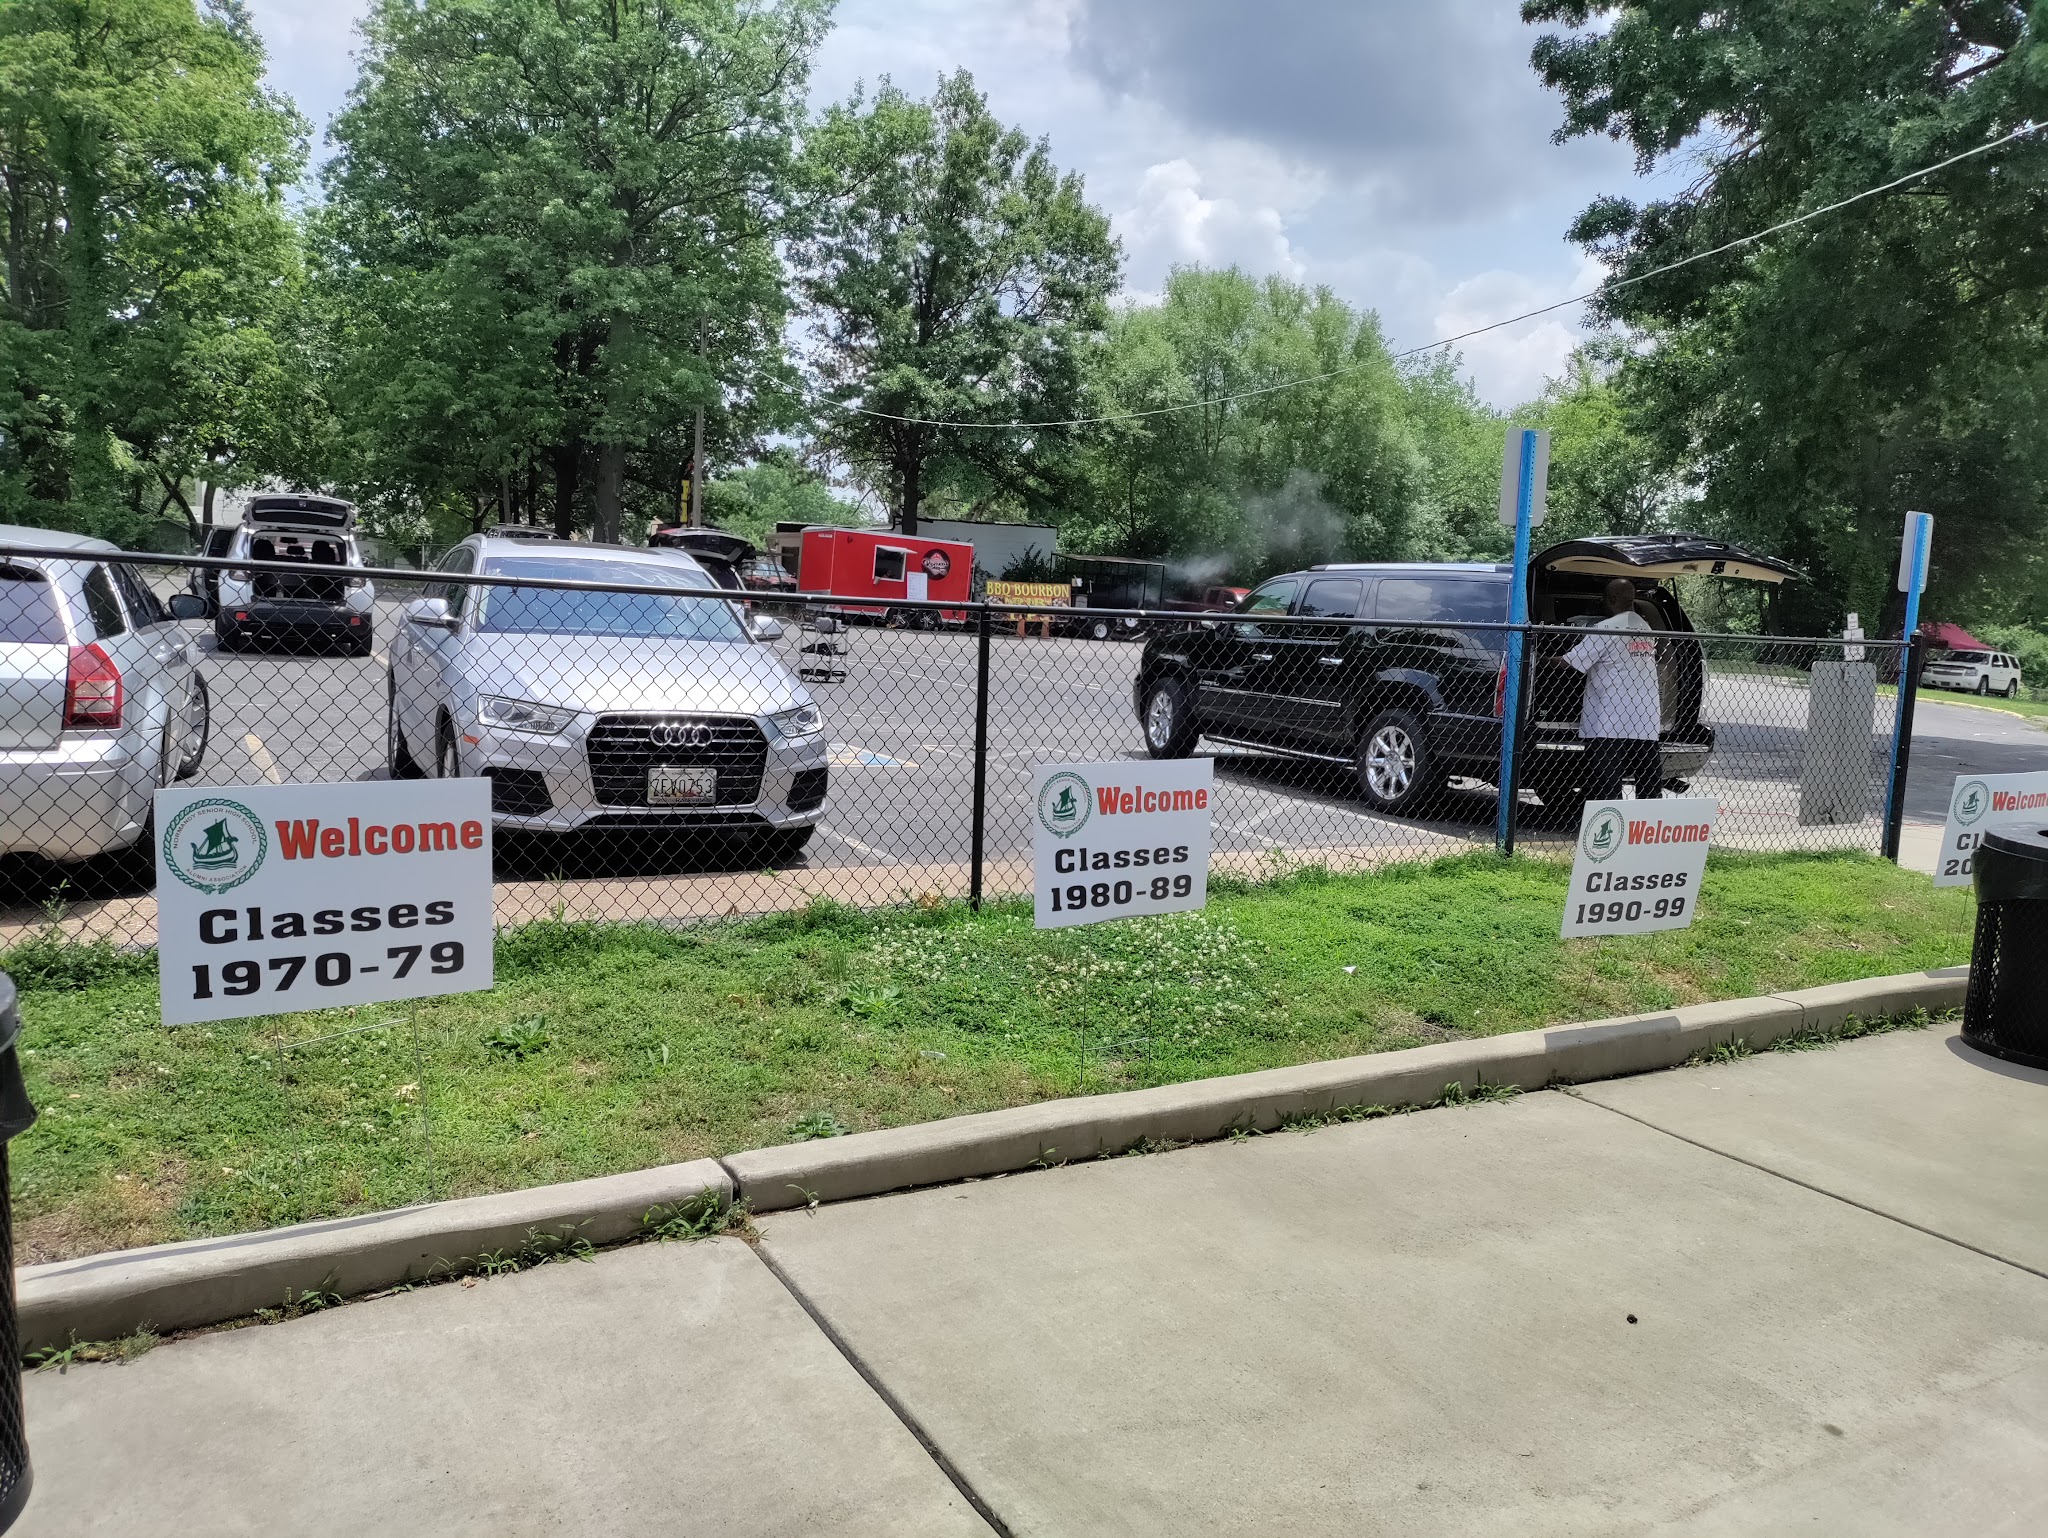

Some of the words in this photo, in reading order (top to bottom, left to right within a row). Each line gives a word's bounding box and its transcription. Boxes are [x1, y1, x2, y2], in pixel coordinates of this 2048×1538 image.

[986, 582, 1011, 597] BBQ
[1015, 584, 1069, 598] BOURBON
[1097, 785, 1208, 815] Welcome
[1992, 791, 2048, 811] Welcom
[173, 813, 196, 849] NORMANDY
[197, 807, 224, 816] SENIOR
[225, 809, 242, 819] HIGH
[241, 817, 258, 845] SCHOOL
[275, 817, 483, 860] Welcome
[1628, 820, 1710, 845] Welcome
[186, 868, 208, 882] ALUMNI
[208, 864, 248, 882] ASSOCIATION
[1055, 845, 1189, 873] Classes
[1051, 874, 1192, 912] 1980-89
[1585, 872, 1688, 893] Classes
[199, 901, 455, 944] Classes
[1575, 897, 1686, 924] 1990-99
[192, 941, 464, 999] 1970-79
